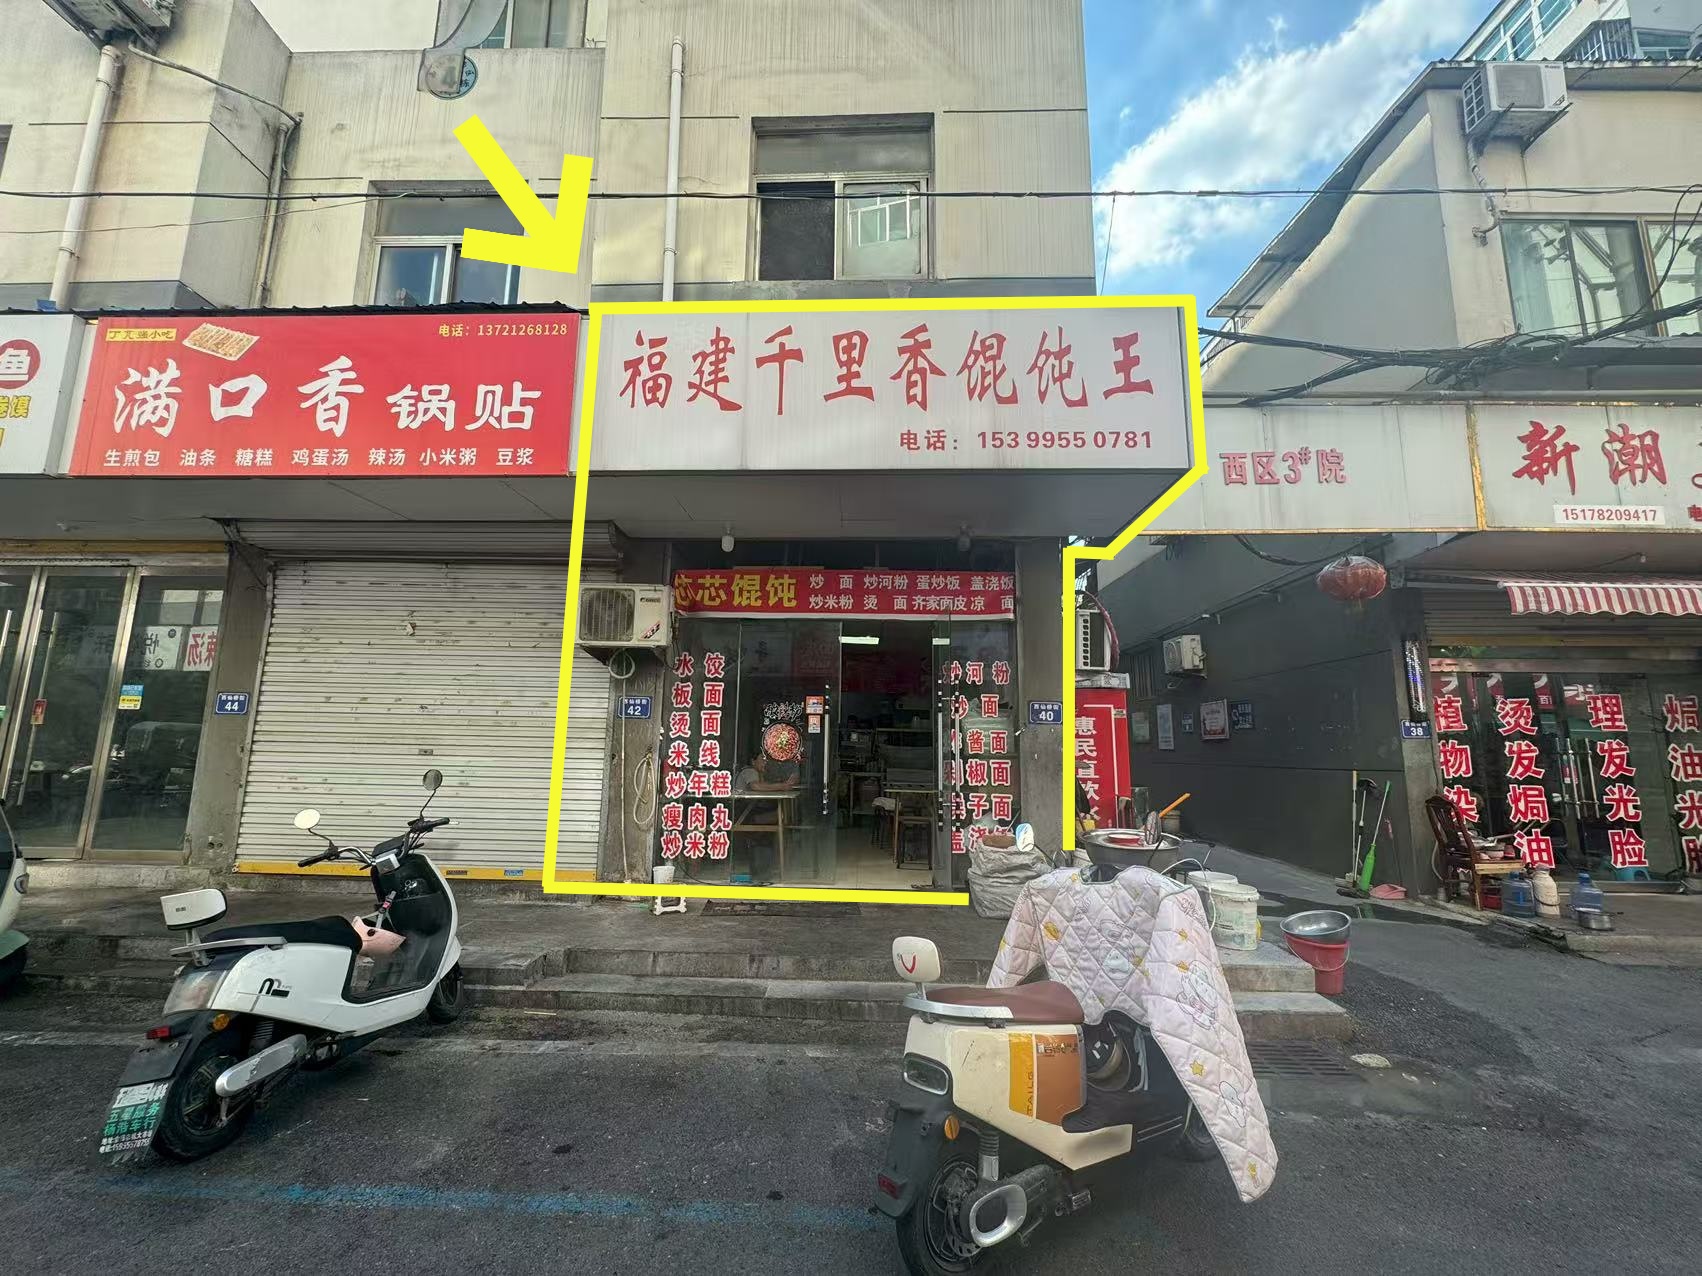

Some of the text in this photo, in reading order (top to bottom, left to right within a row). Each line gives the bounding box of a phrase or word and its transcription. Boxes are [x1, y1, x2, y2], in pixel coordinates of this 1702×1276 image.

[477, 324, 568, 336] 13721268128
[618, 322, 1155, 416] 福建千里香馄饨王
[113, 355, 542, 438] 满口香锅贴
[103, 447, 535, 467] 生煎包 油条 糖糕 鸡蛋汤 辣汤 小米粥 豆浆
[1562, 508, 1657, 521] 15178209417
[863, 574, 909, 590] 炒河粉
[916, 575, 961, 591] 蛋炒饭
[969, 576, 1014, 591] 盖浇饭
[808, 595, 854, 610] 炒米粉
[224, 701, 239, 711] 44
[627, 705, 642, 716] 42
[1039, 710, 1054, 721] 40
[1410, 727, 1424, 736] 38
[665, 770, 732, 799] 炒年糕
[1496, 697, 1556, 870] 烫发焗油
[1585, 693, 1649, 869] 理发光脸
[662, 802, 732, 831] 瘦肉丸
[661, 831, 730, 859] 炒米粉
